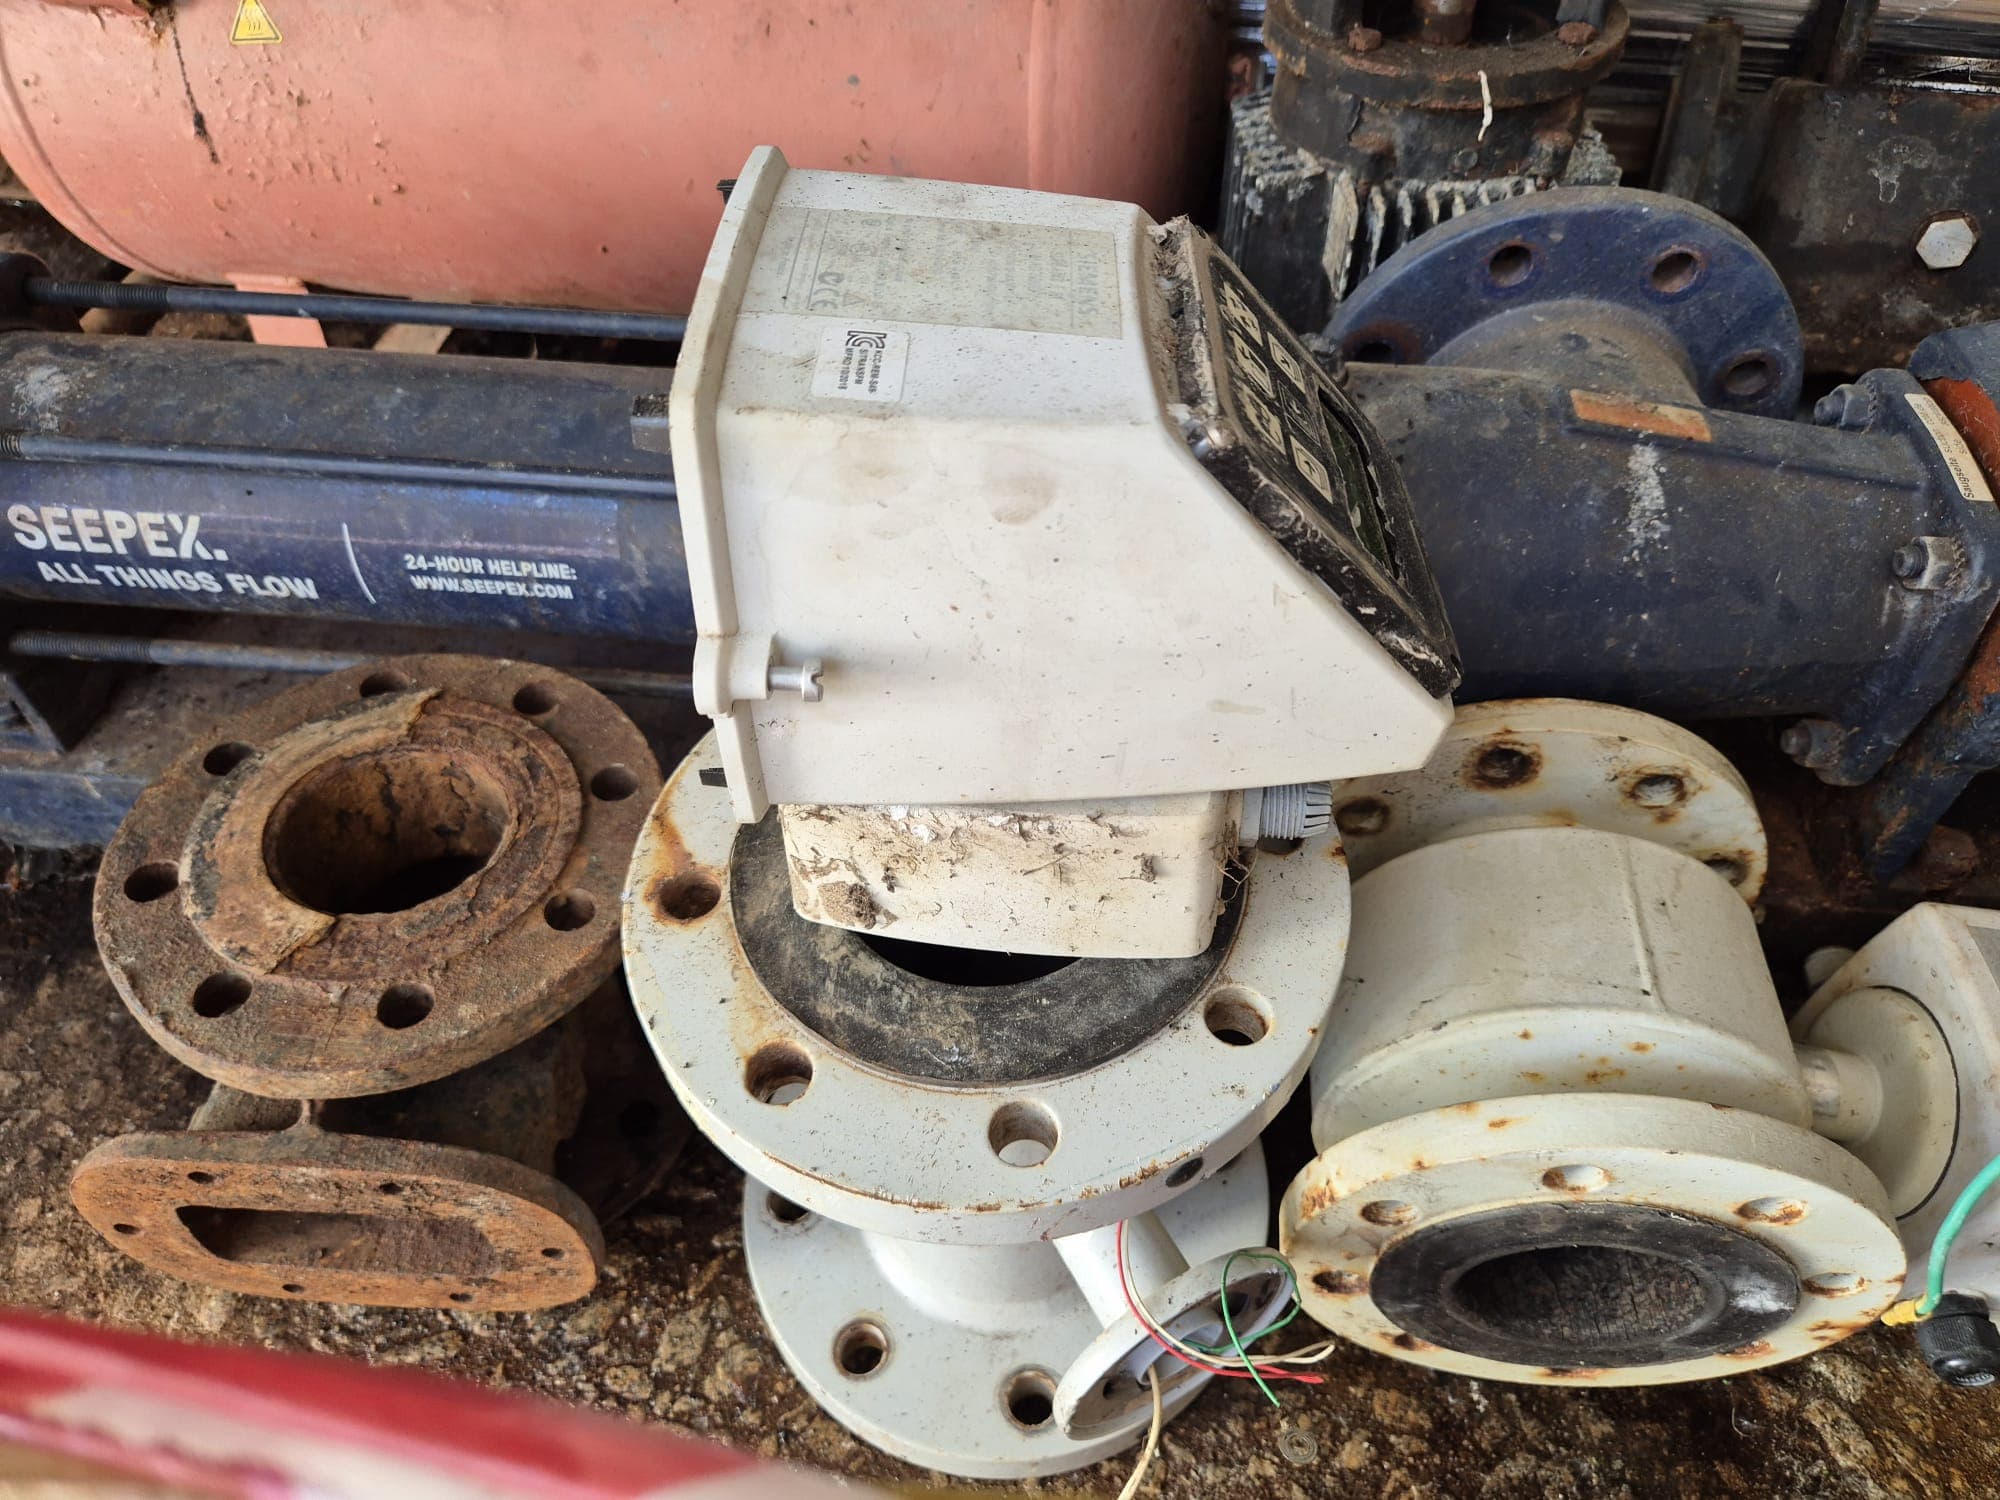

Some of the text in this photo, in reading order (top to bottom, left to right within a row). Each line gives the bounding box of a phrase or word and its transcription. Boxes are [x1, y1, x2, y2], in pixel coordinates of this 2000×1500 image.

[1078, 251, 1099, 314] SIEMENS
[37, 561, 320, 600] ALL THINGS FLOW
[403, 553, 577, 580] 24-HOUR HELPLINE:
[410, 574, 574, 600] WWW.SEEPEX.COM
